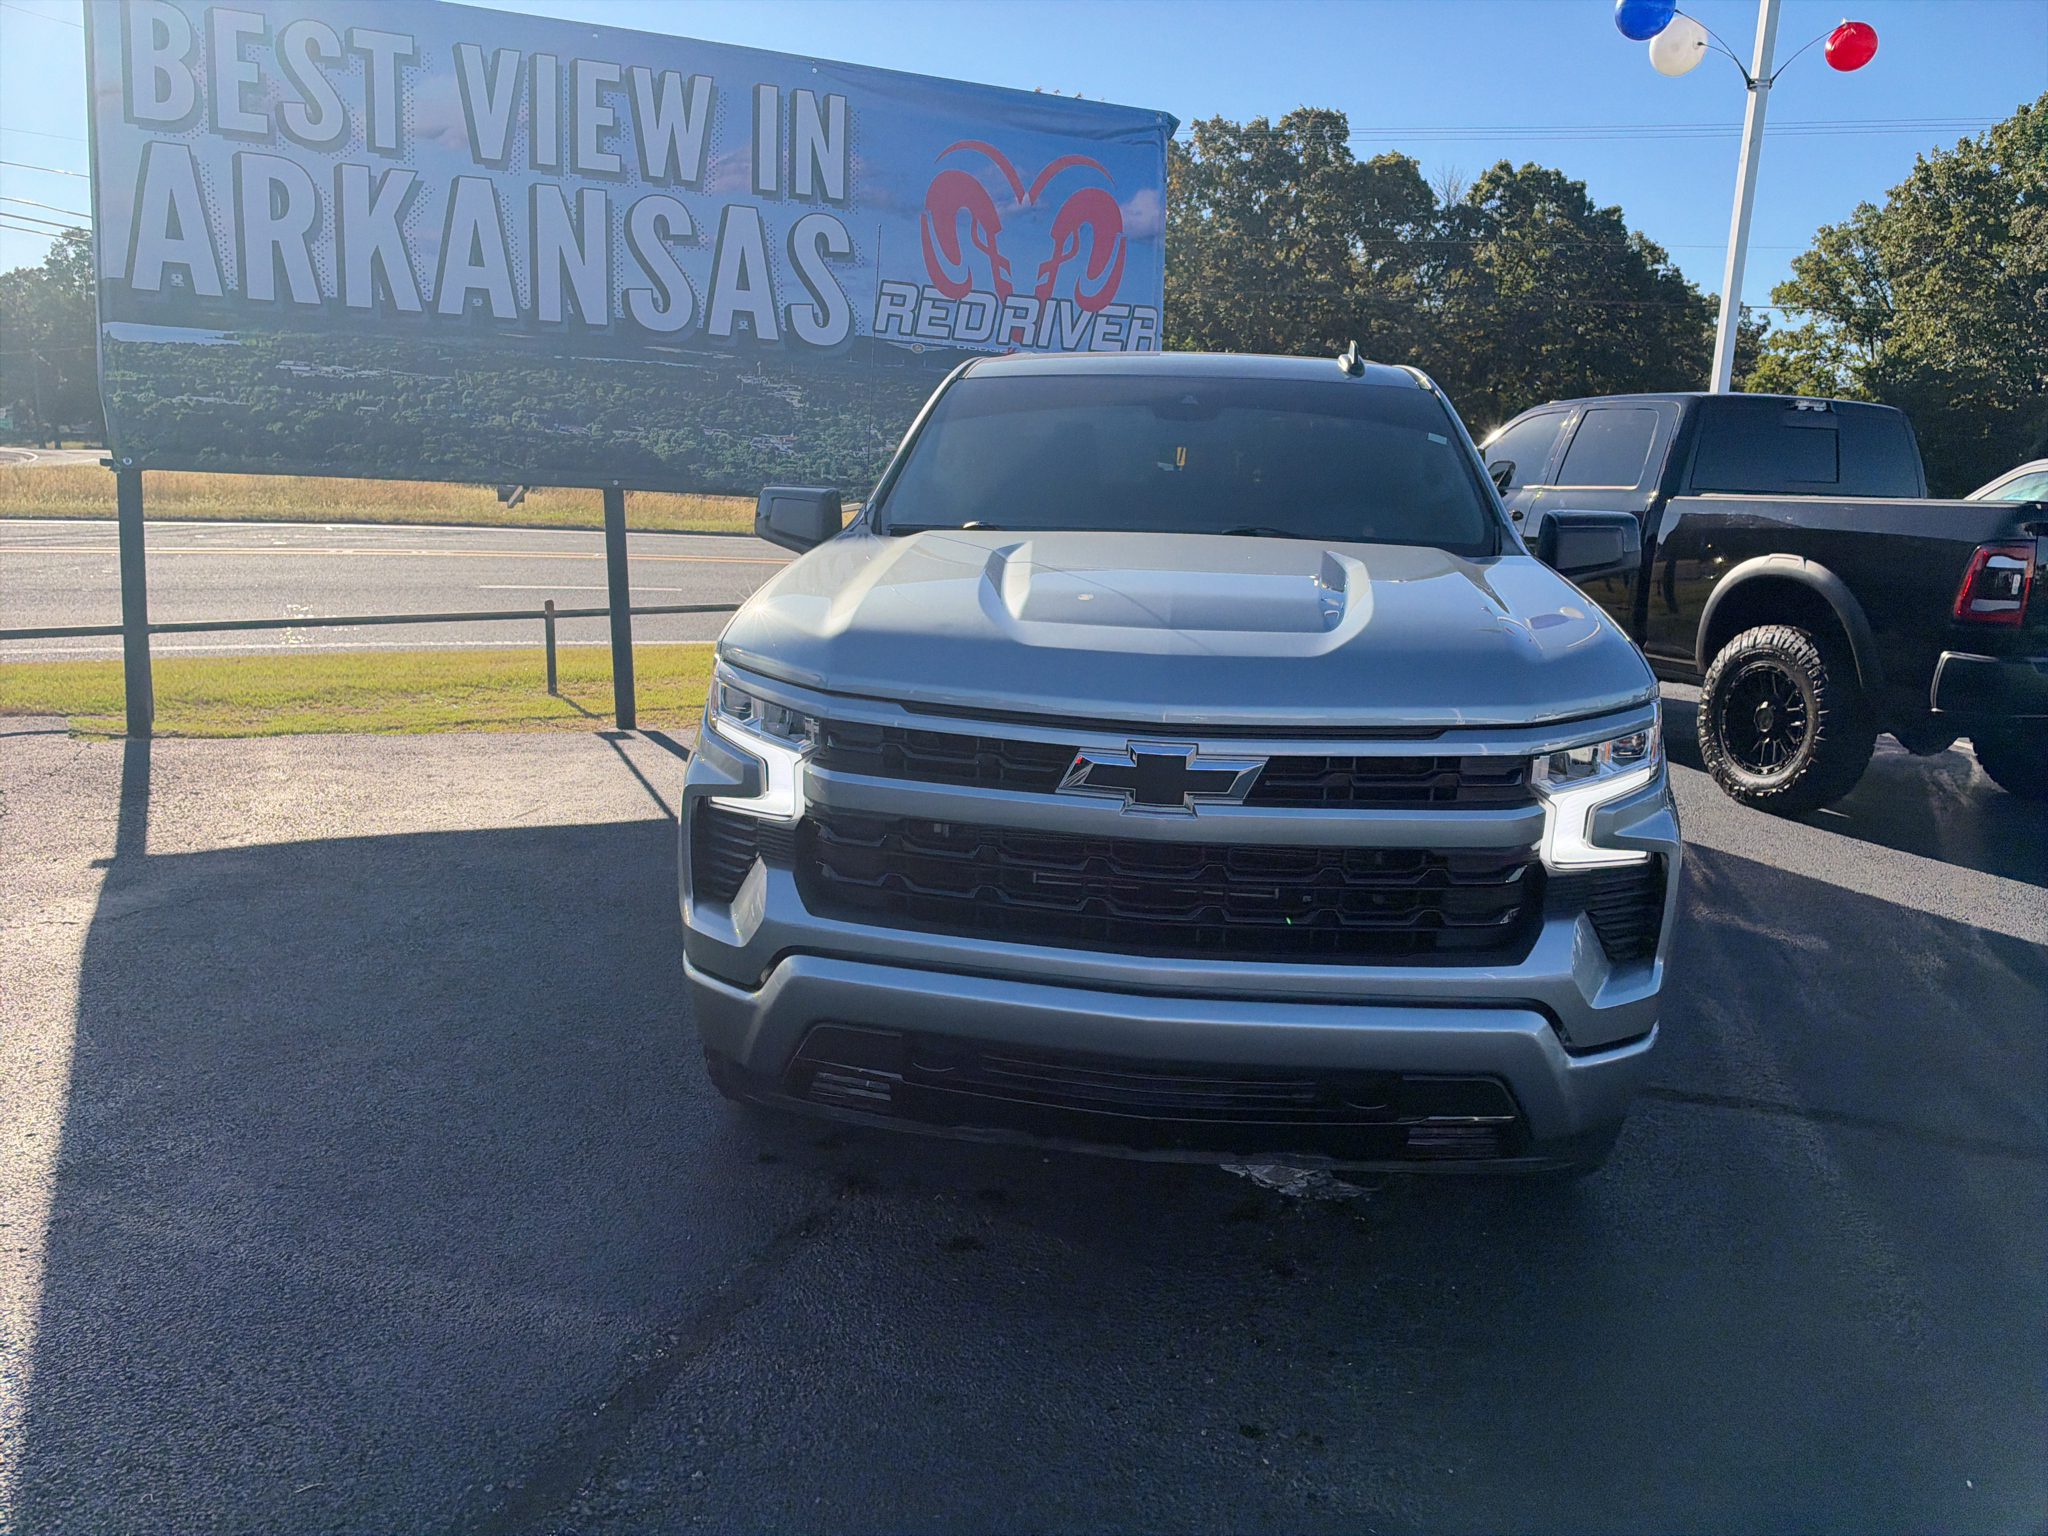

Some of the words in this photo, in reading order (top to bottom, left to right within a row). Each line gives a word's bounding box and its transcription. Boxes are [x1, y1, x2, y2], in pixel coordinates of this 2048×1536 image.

[122, 0, 416, 157] BEST
[452, 42, 716, 186] VIEW
[752, 83, 849, 201] IN
[126, 140, 852, 348] ARKANSAS
